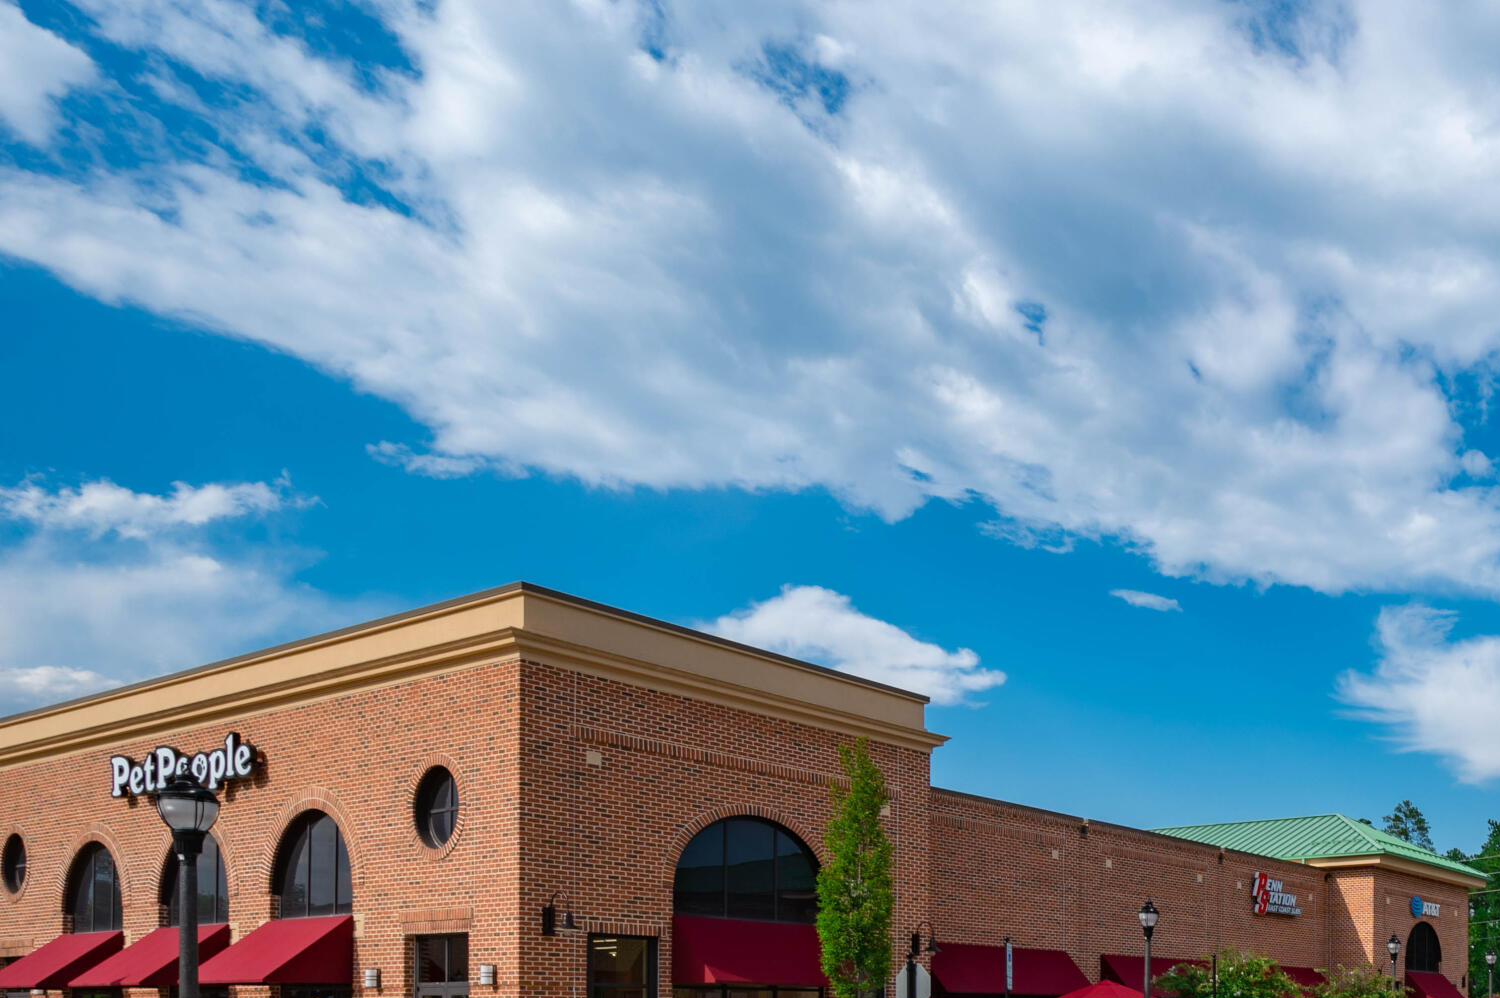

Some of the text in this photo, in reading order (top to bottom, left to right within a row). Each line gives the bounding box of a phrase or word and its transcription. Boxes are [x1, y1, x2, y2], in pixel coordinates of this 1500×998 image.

[1253, 871, 1283, 896] PENN
[1255, 890, 1297, 914] STATION
[1422, 901, 1440, 917] AT&T
